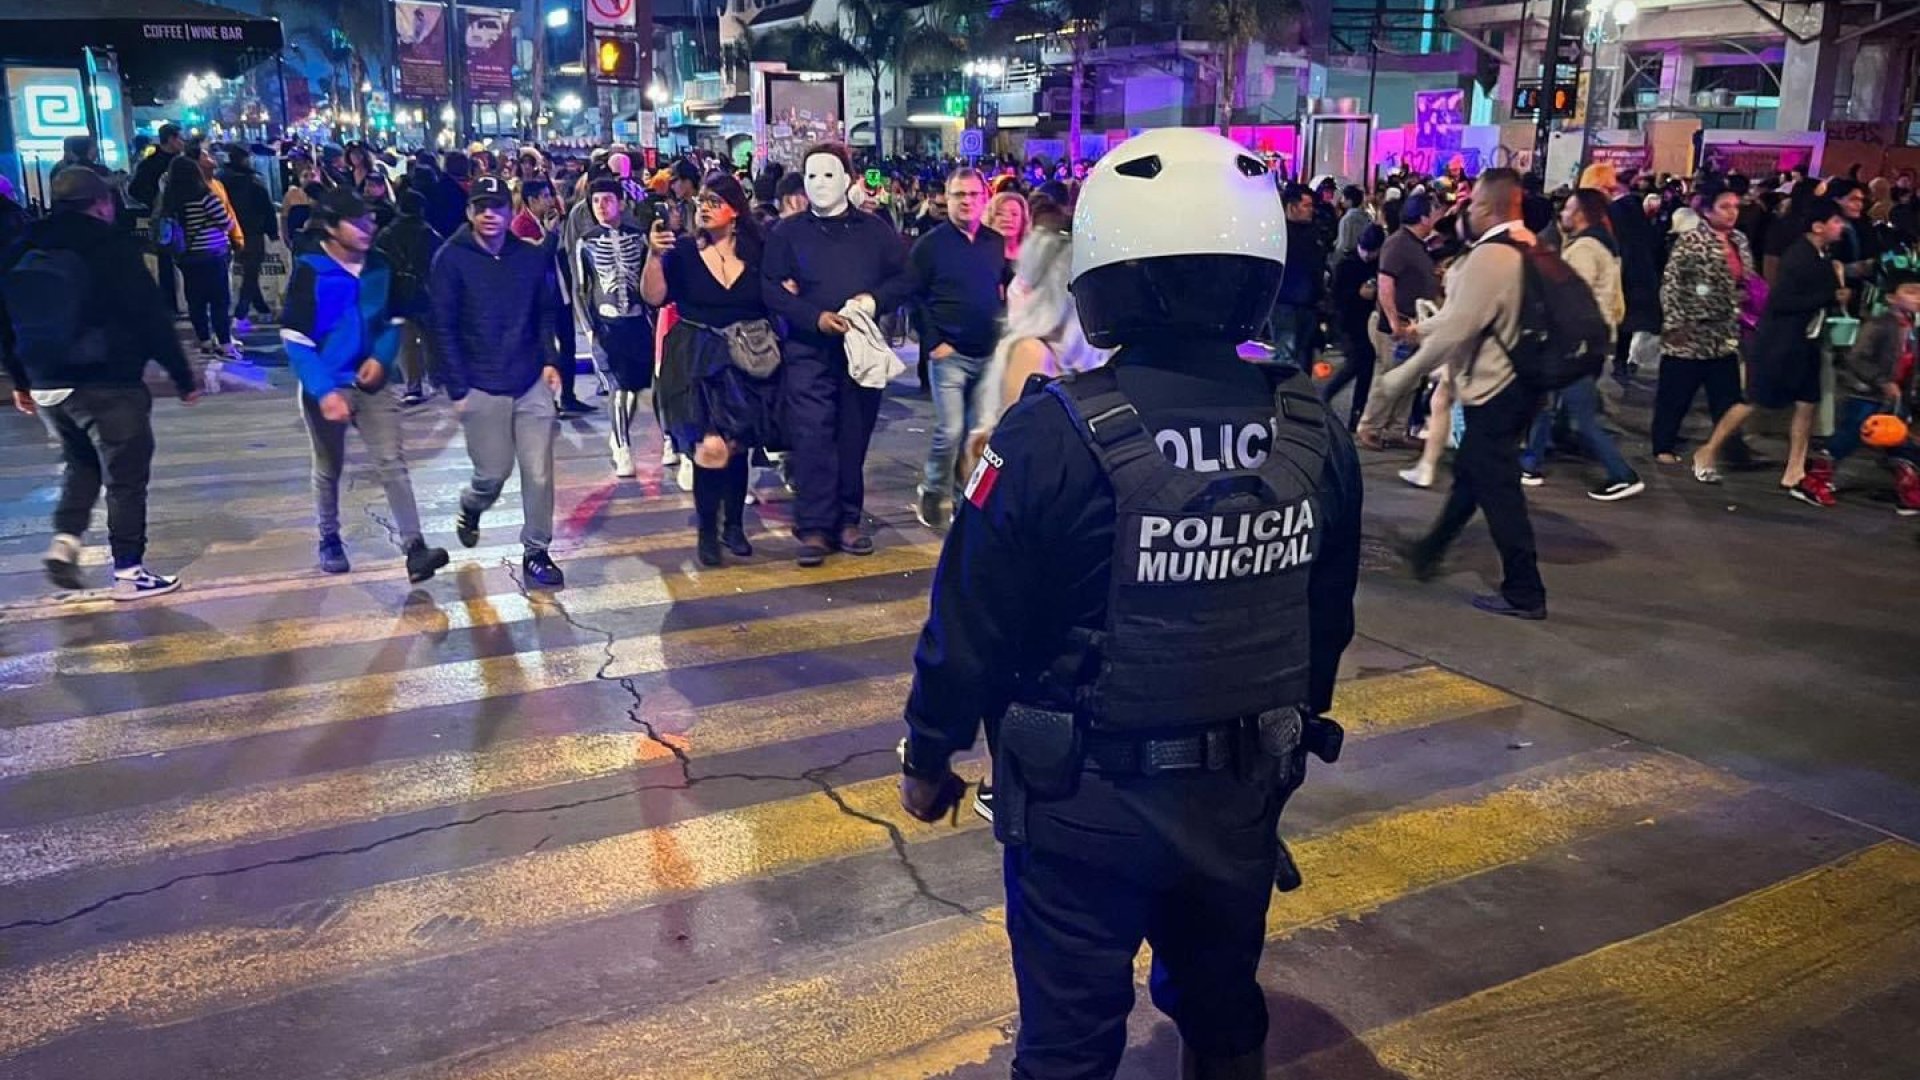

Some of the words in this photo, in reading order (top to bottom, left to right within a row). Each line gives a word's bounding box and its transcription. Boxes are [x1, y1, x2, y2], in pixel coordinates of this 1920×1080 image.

[143, 24, 183, 39] COFFEE
[191, 25, 219, 40] WINE
[220, 26, 243, 41] BAR
[1155, 416, 1278, 472] OLIC
[1139, 499, 1314, 549] POLICIA
[1137, 534, 1313, 582] MUNICIPAL
